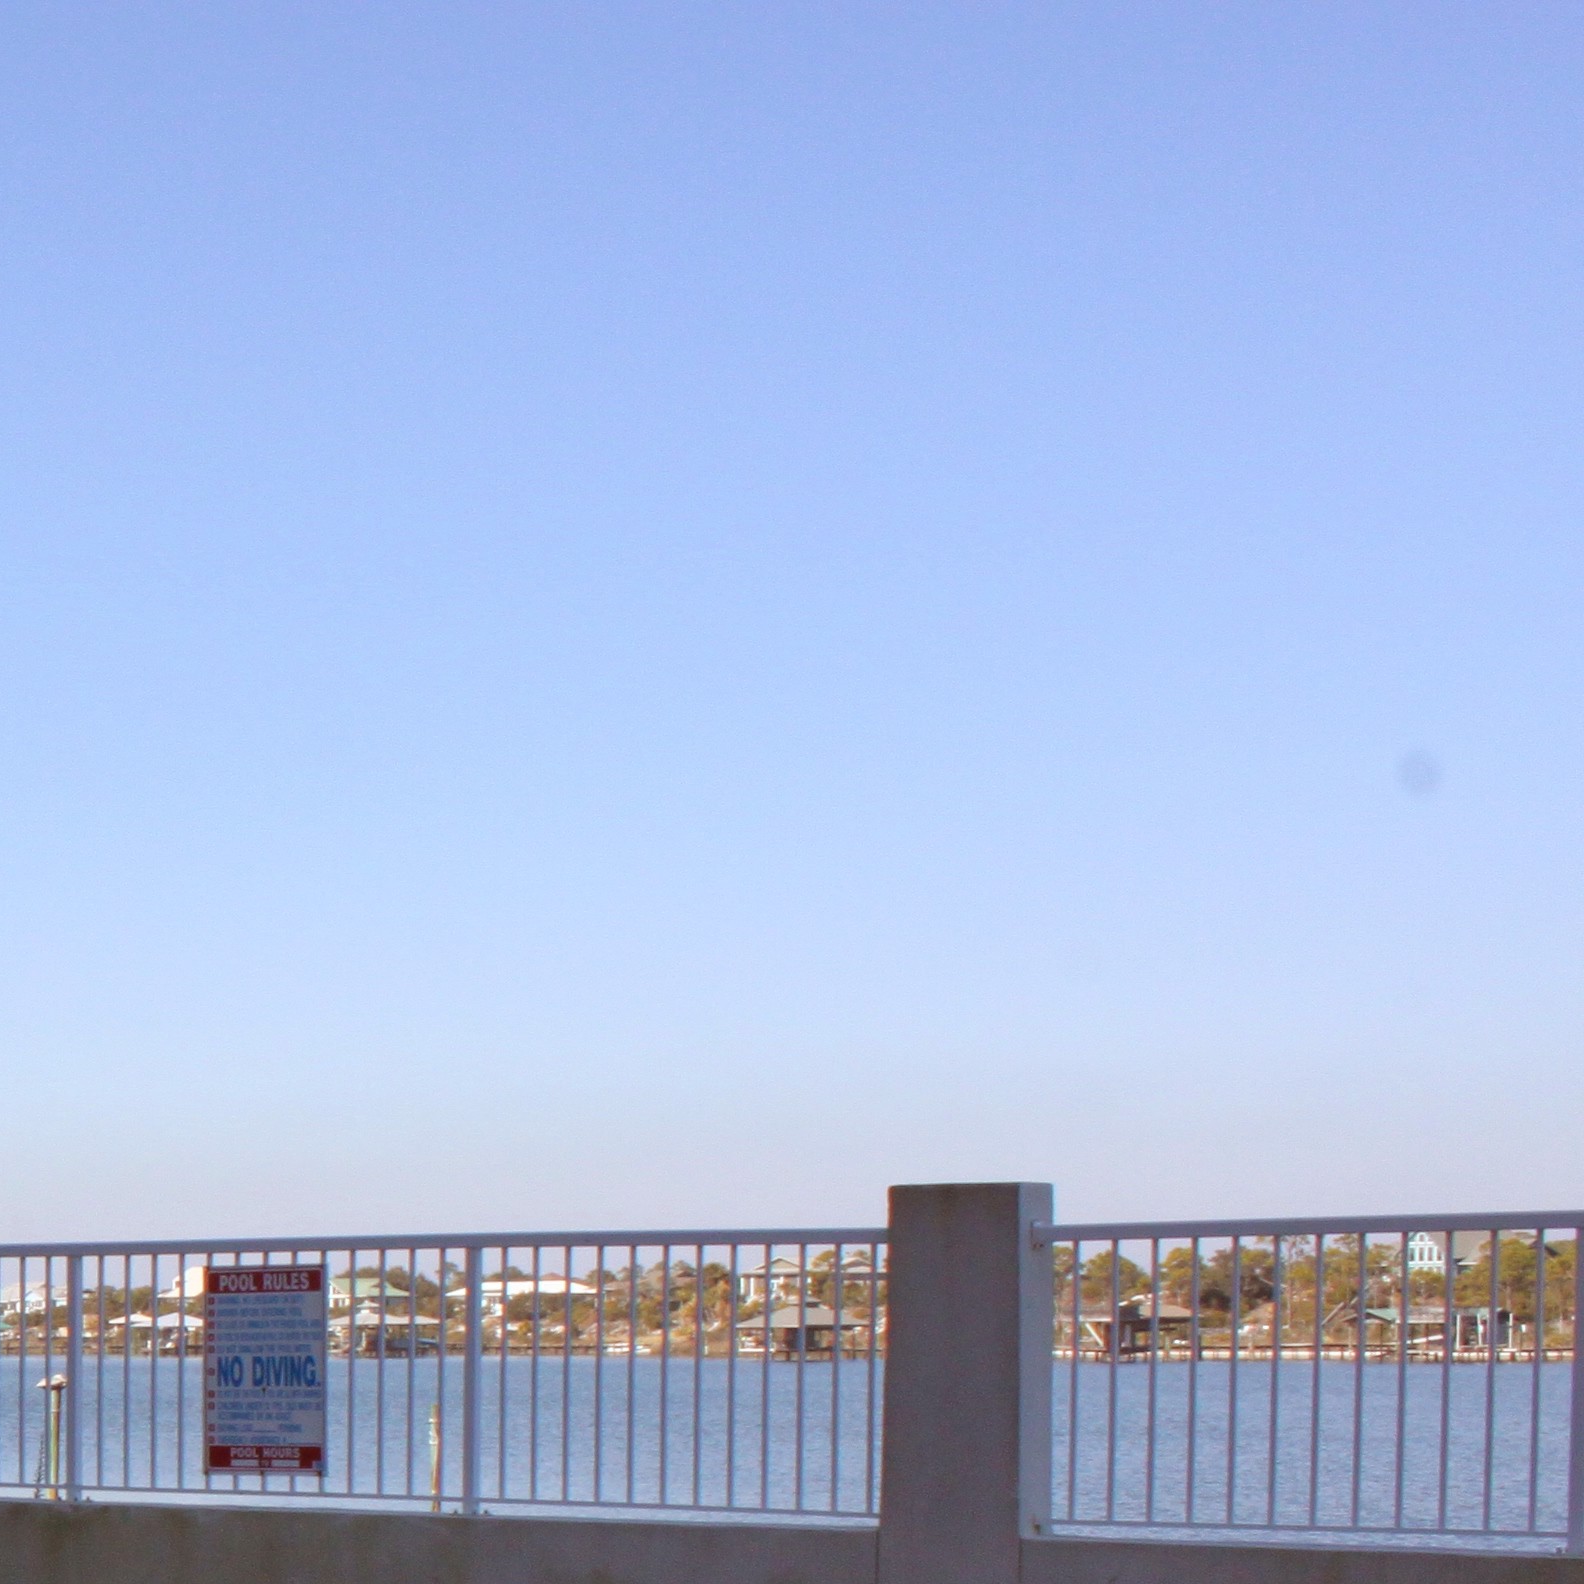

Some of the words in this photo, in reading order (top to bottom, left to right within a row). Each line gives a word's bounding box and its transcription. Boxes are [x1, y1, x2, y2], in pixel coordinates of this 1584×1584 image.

[219, 1274, 257, 1292] POOL
[262, 1272, 310, 1291] RULES
[216, 1354, 243, 1388] NO
[230, 1446, 259, 1459] POOL
[262, 1446, 300, 1459] HOURS
